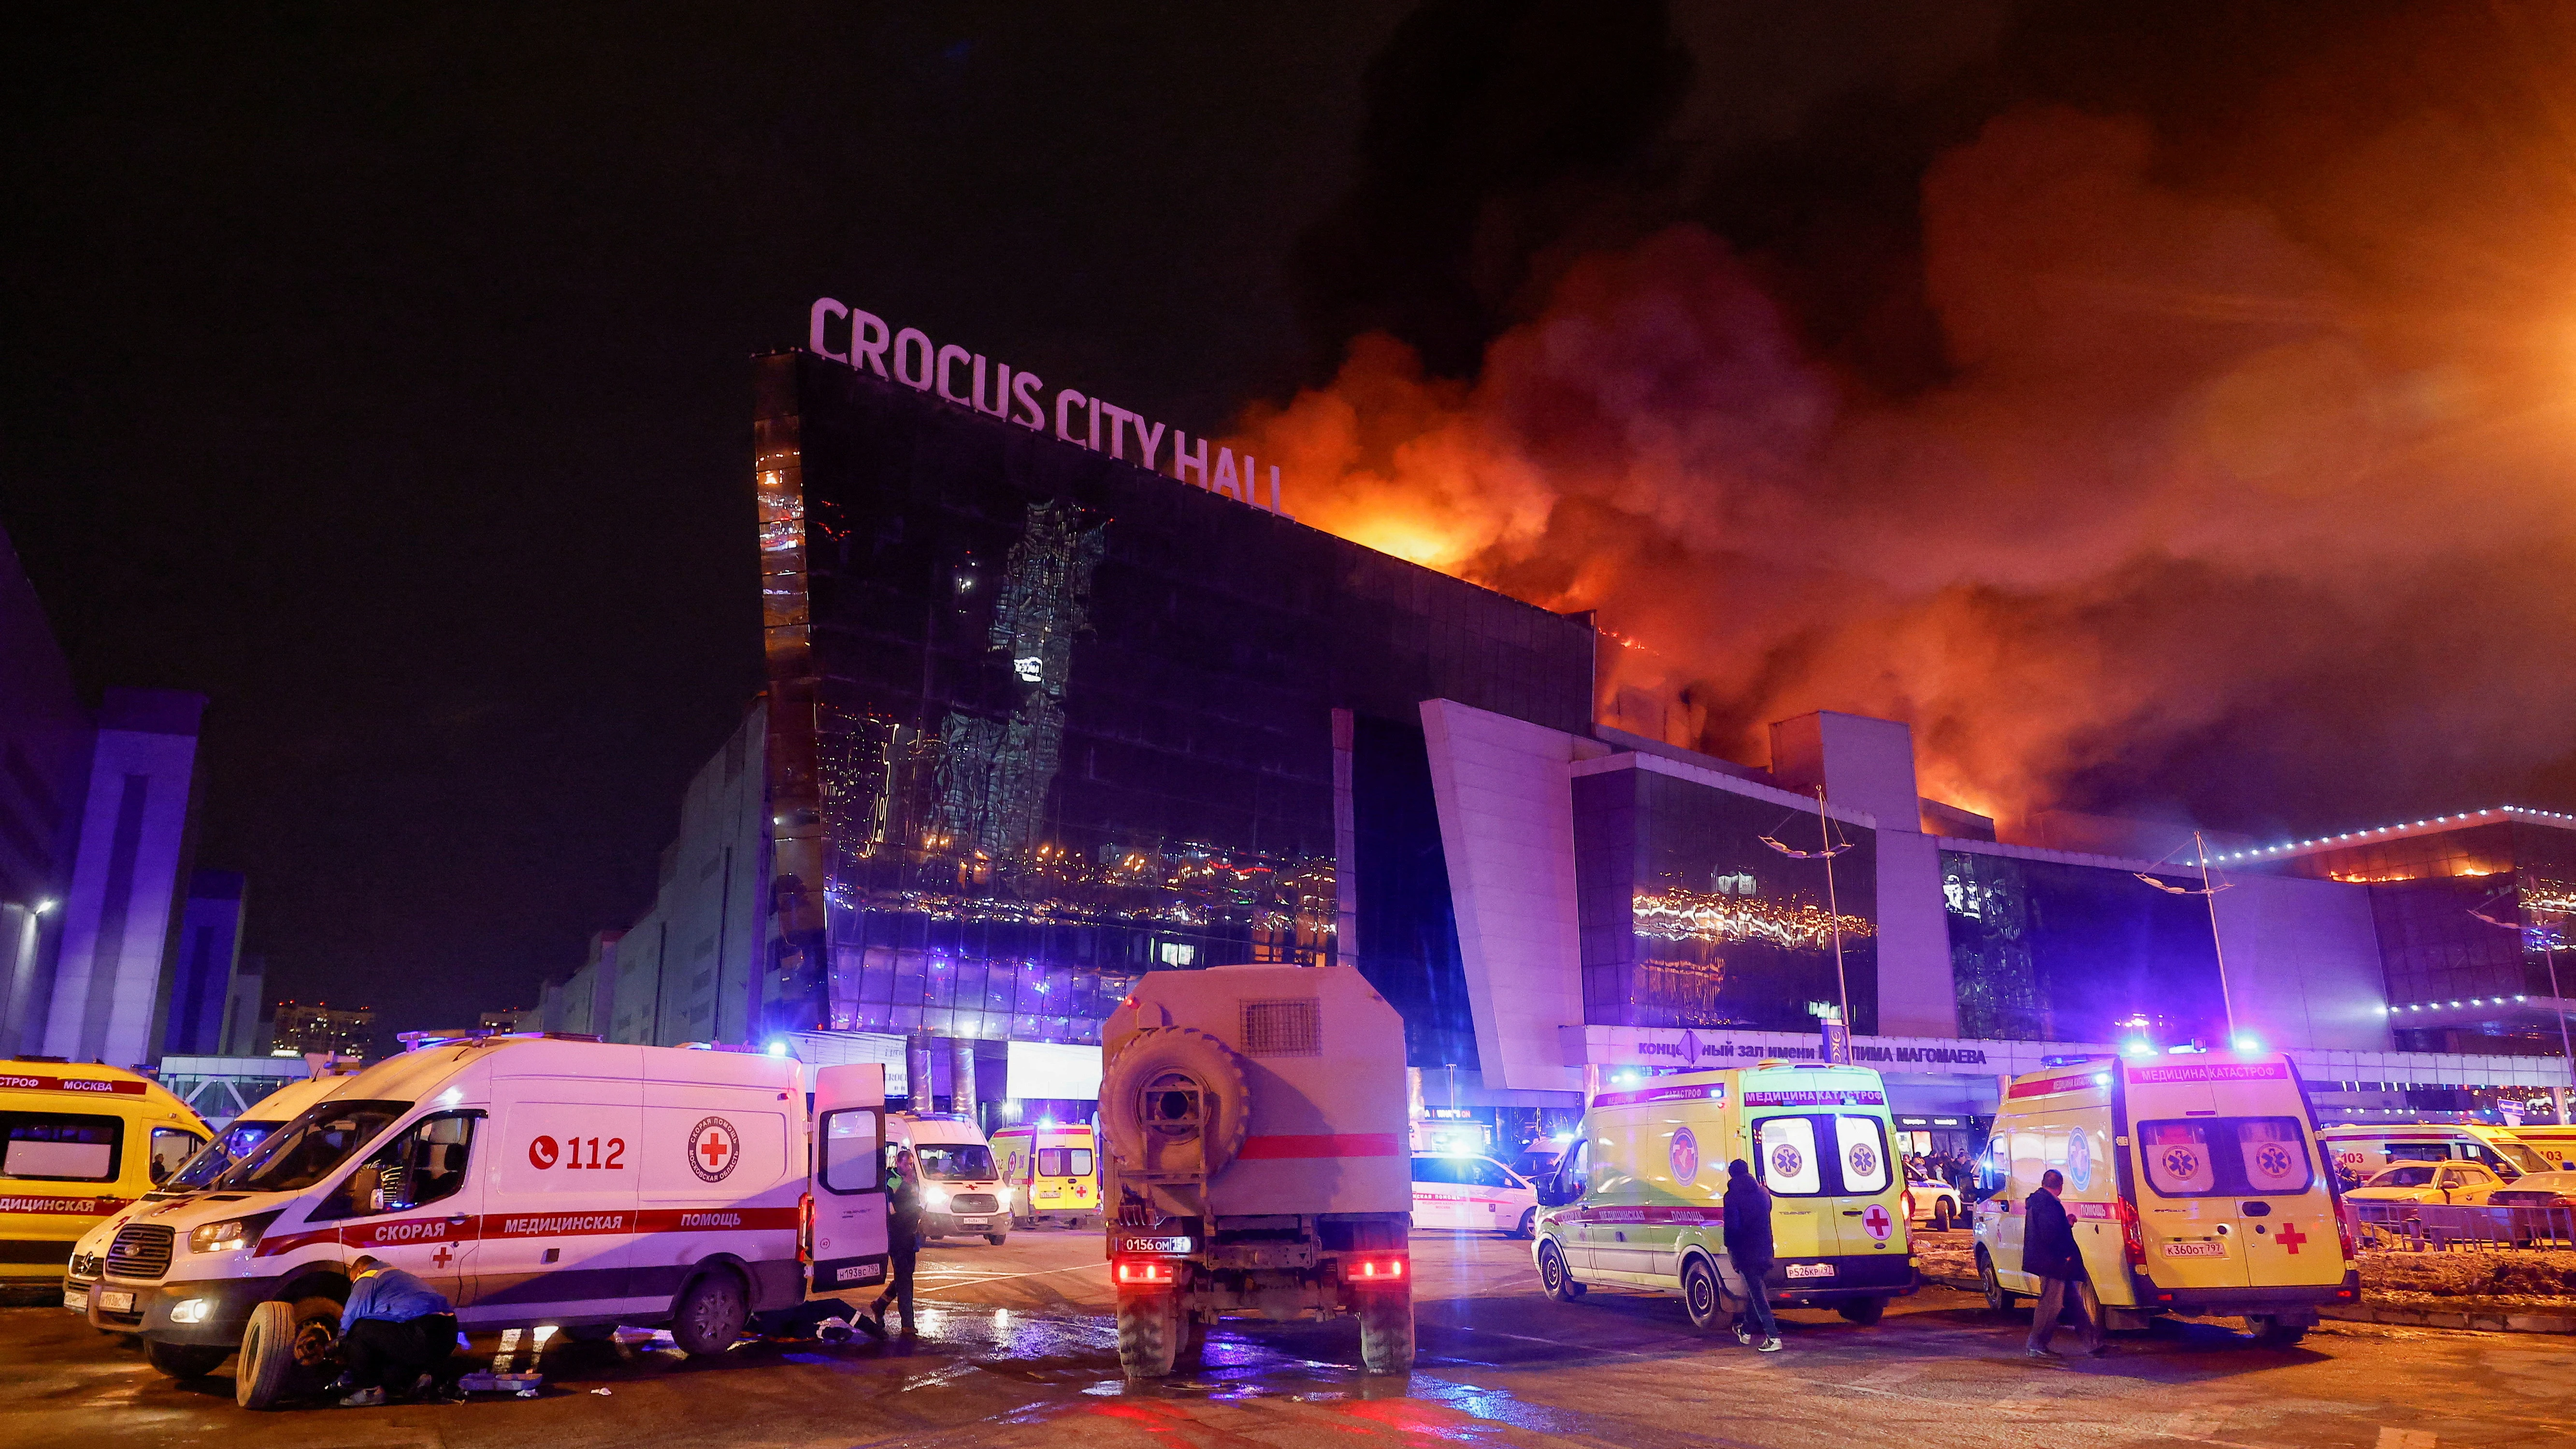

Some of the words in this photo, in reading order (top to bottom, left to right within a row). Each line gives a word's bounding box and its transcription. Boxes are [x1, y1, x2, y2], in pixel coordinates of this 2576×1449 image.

[810, 297, 1045, 431] CROCUS
[1056, 389, 1166, 471] CITY
[1174, 430, 1295, 521] HALL
[1738, 1045, 1764, 1058] зал
[1768, 1048, 1814, 1059] имени
[1897, 1047, 1987, 1064] МАГОМАЕВА
[2142, 1068, 2207, 1082] МЕДИЦИНА
[2209, 1066, 2274, 1078] КАТАСТРОФ
[63, 1081, 113, 1091] МОСКВА
[1607, 1096, 1637, 1105] МЕДИЦИНА
[1745, 1092, 1815, 1102] МЕДИЦИНА
[1817, 1091, 1882, 1100] КАТАСТРОФ
[690, 1118, 711, 1143] СКОРАЯ
[714, 1118, 737, 1144] ПОМОЩЬ
[567, 1137, 625, 1169] 112
[2341, 1153, 2364, 1163] 103
[689, 1150, 718, 1181] МОСКОВСКАЯ
[720, 1150, 739, 1179] ОБЛАСТЬ
[1599, 1210, 1645, 1222] МЕДИЦИНСКАЯ
[1671, 1210, 1704, 1223] ПОМОЩЬ
[2080, 1204, 2106, 1218] ПОМОЩЬ
[375, 1222, 446, 1241] СКОРАЯ
[504, 1216, 622, 1234] МЕДИЦИНСКАЯ
[681, 1213, 741, 1228] ПОМОЩЬ
